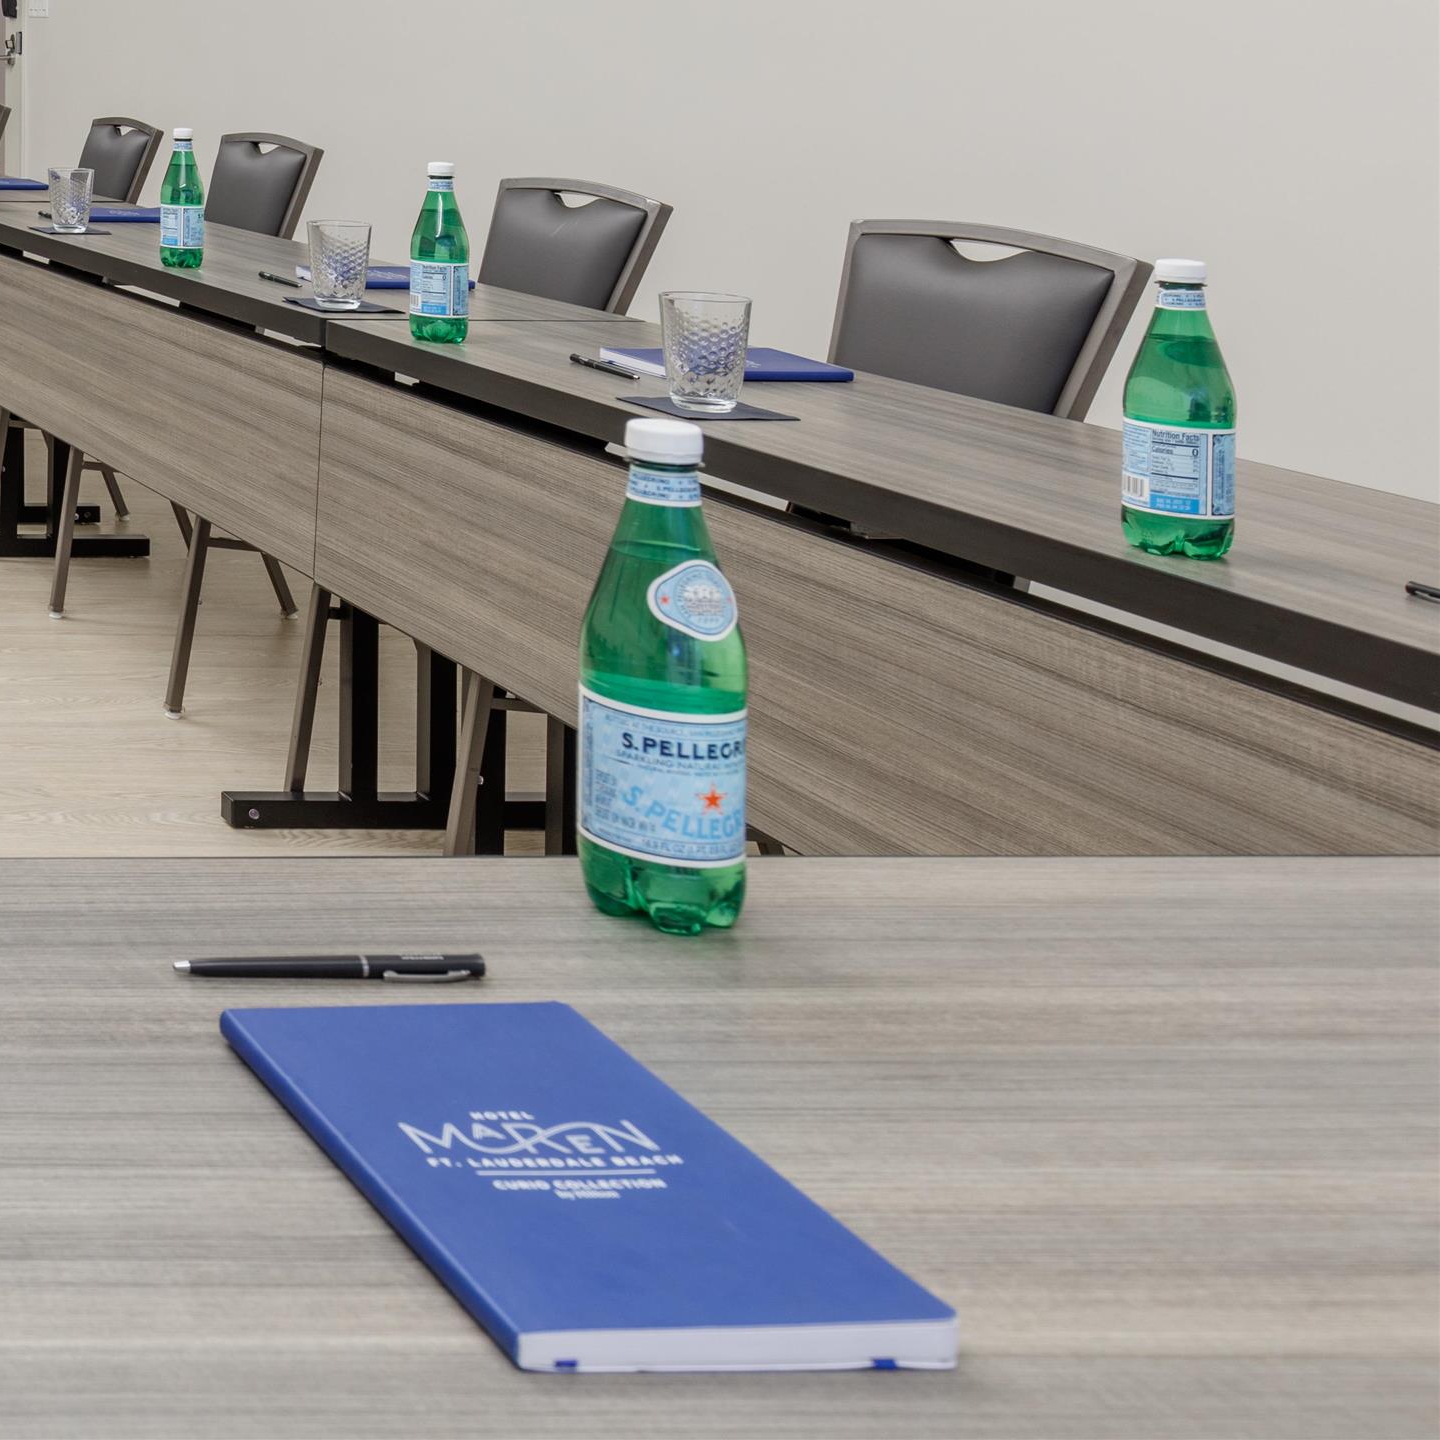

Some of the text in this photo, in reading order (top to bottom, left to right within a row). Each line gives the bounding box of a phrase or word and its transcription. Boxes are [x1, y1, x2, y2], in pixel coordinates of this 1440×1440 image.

[1152, 429, 1180, 440] Nutrition
[1182, 432, 1200, 442] Facts
[621, 732, 743, 760] S.PELLEGR
